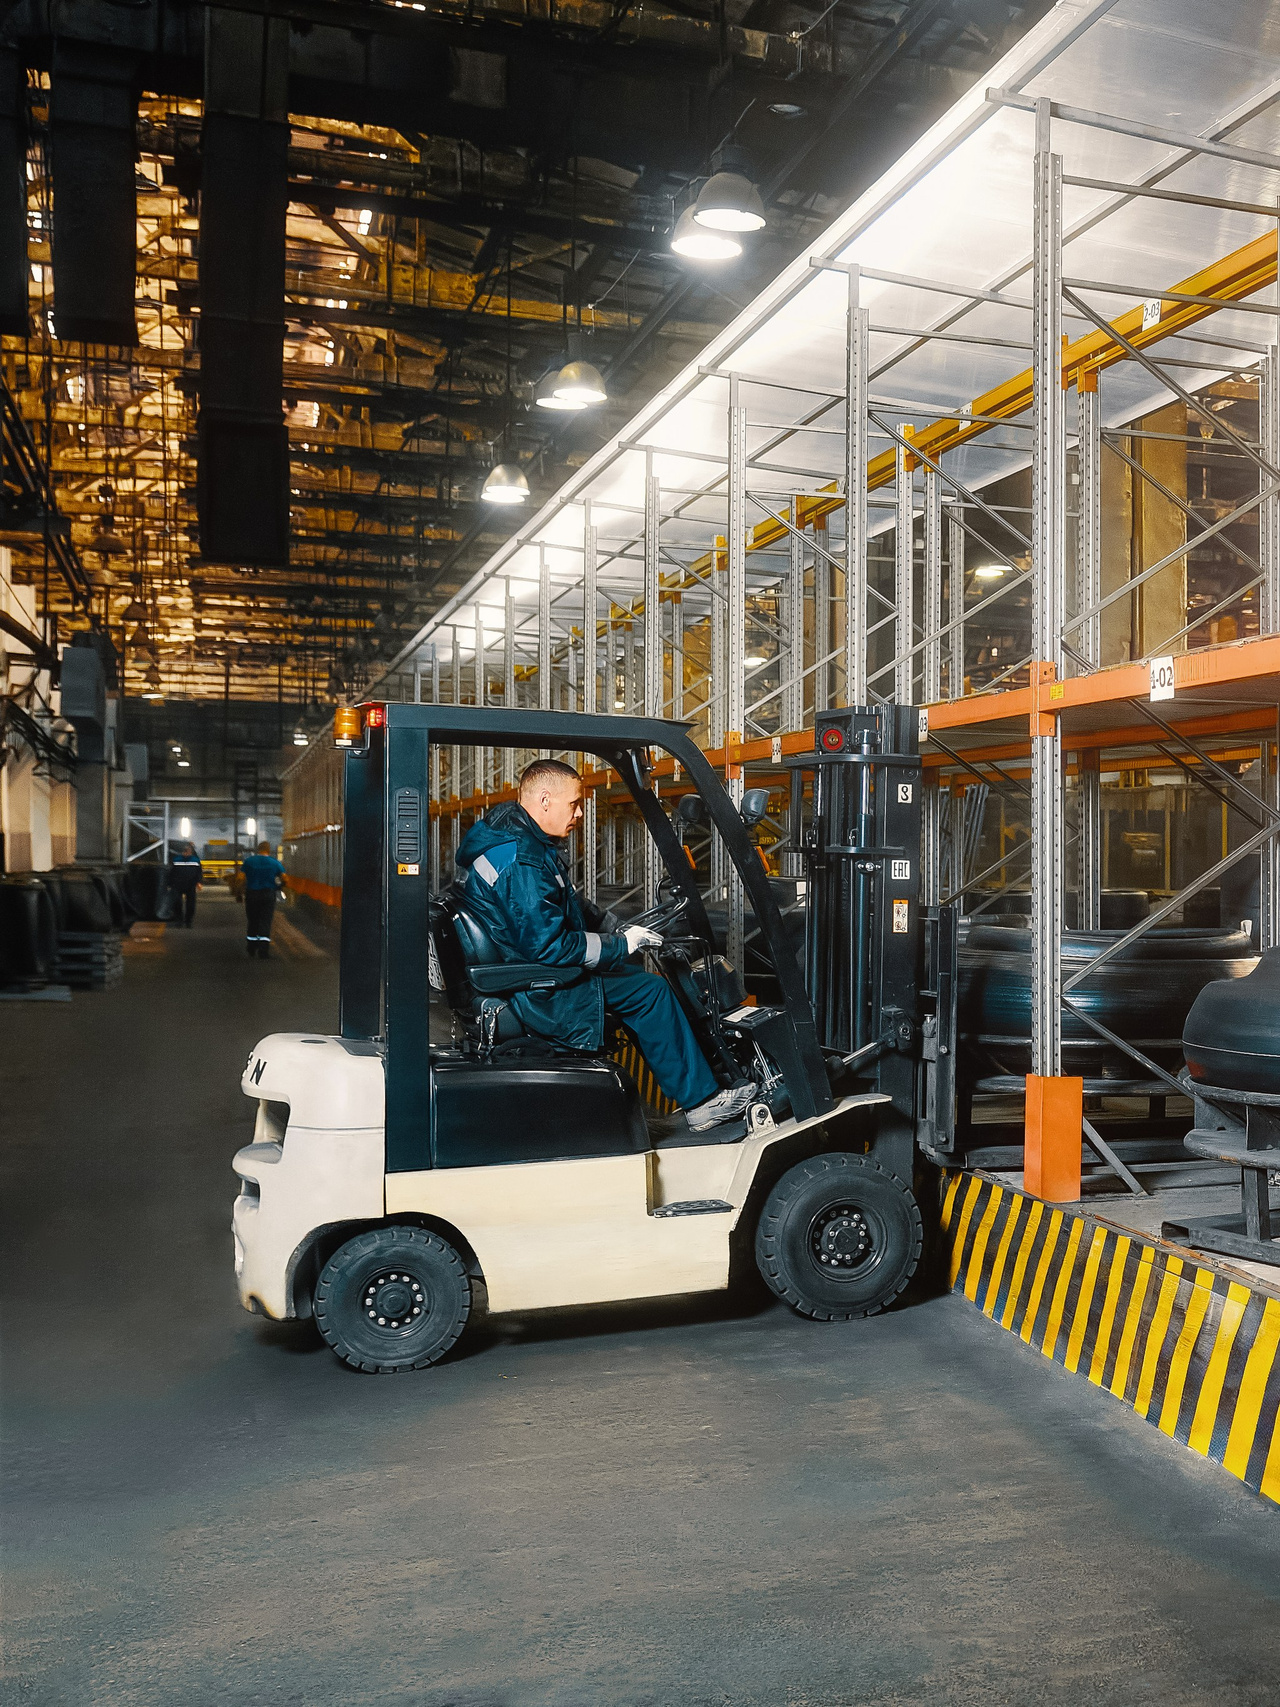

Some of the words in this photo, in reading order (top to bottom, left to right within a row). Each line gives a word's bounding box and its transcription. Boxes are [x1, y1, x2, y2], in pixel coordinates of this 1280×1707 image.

[1143, 301, 1160, 322] 2-03
[1151, 665, 1173, 690] 1-02
[893, 862, 908, 878] EAC
